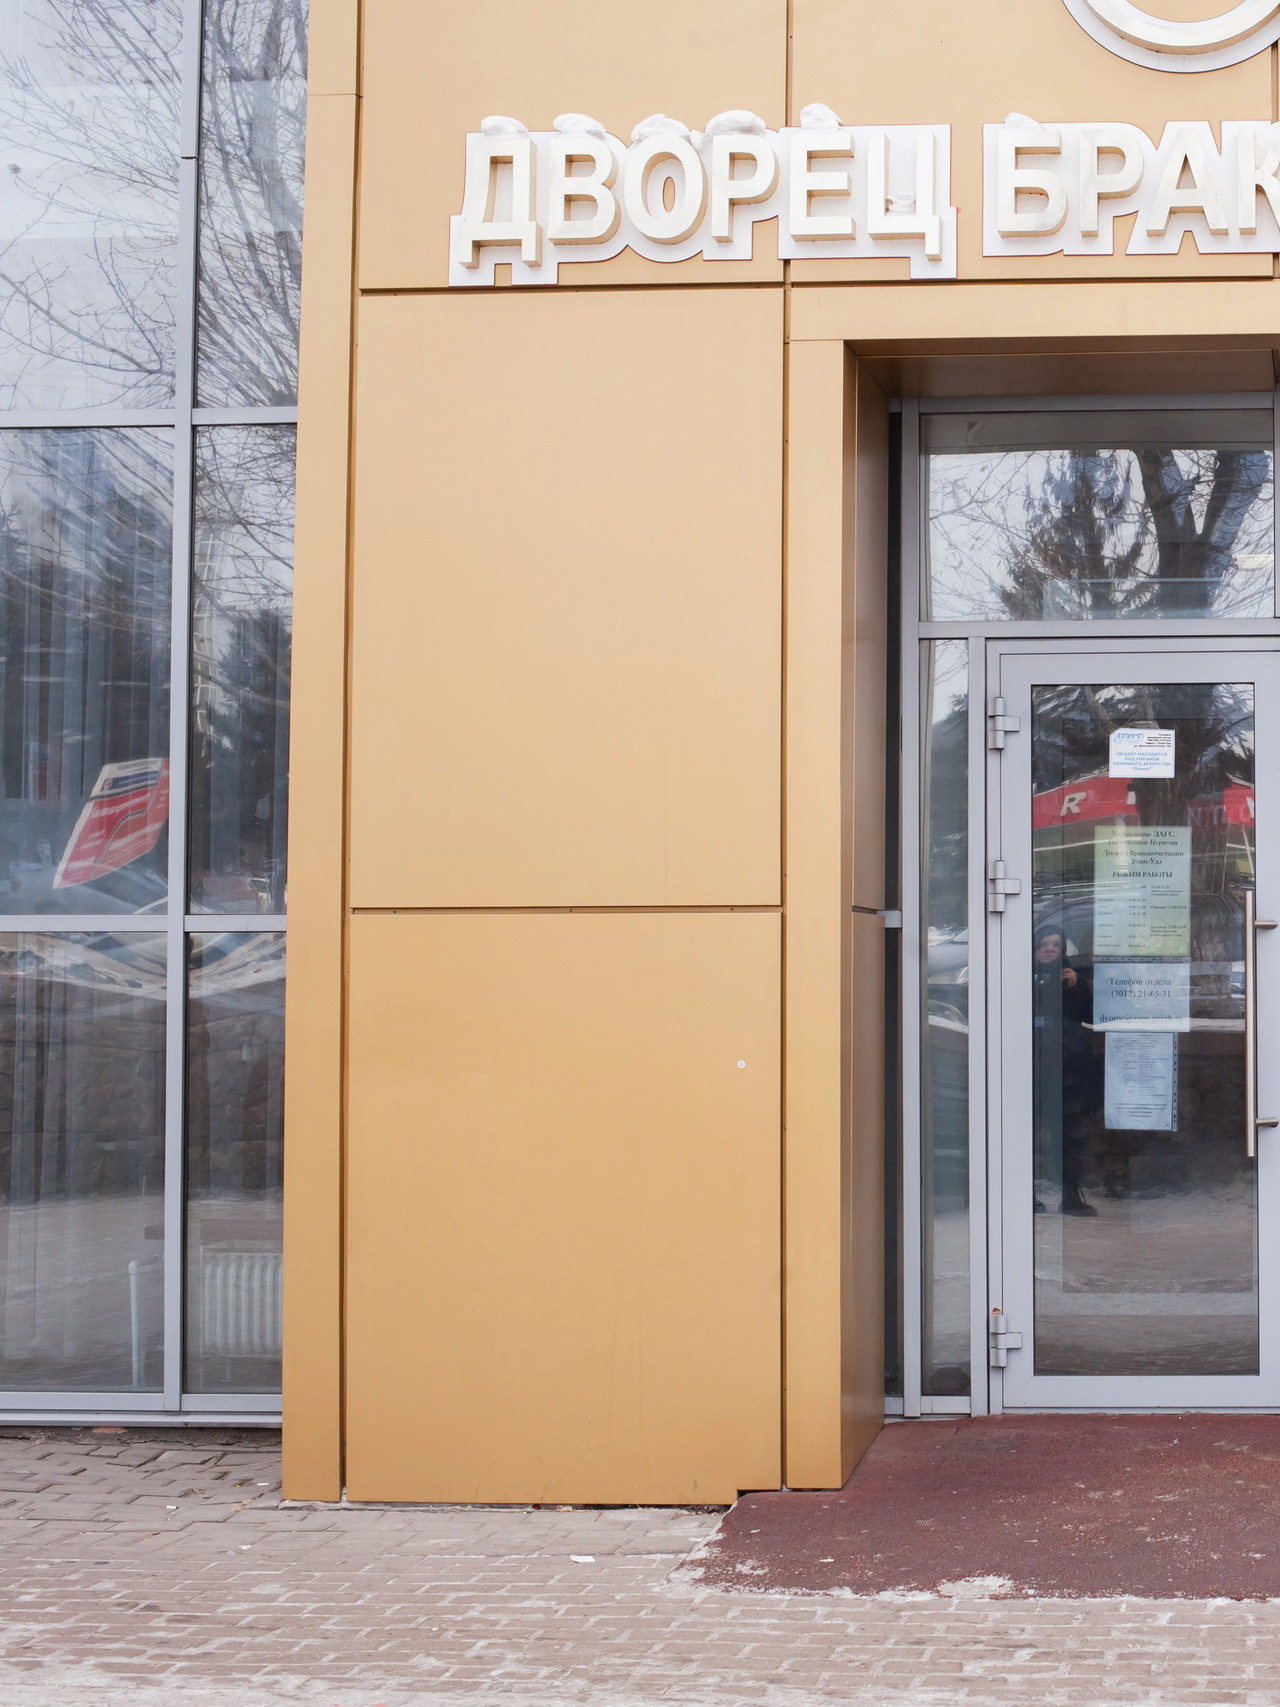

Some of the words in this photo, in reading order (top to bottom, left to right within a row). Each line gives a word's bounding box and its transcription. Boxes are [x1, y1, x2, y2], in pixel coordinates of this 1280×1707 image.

[457, 124, 945, 270] ДВОРЕЦ
[1149, 839, 1178, 847] Бурятия
[1129, 849, 1184, 857] бракосочетания
[1109, 977, 1143, 987] Телефон
[1111, 990, 1136, 999] (3012)
[1138, 990, 1171, 998] 21-65-31
